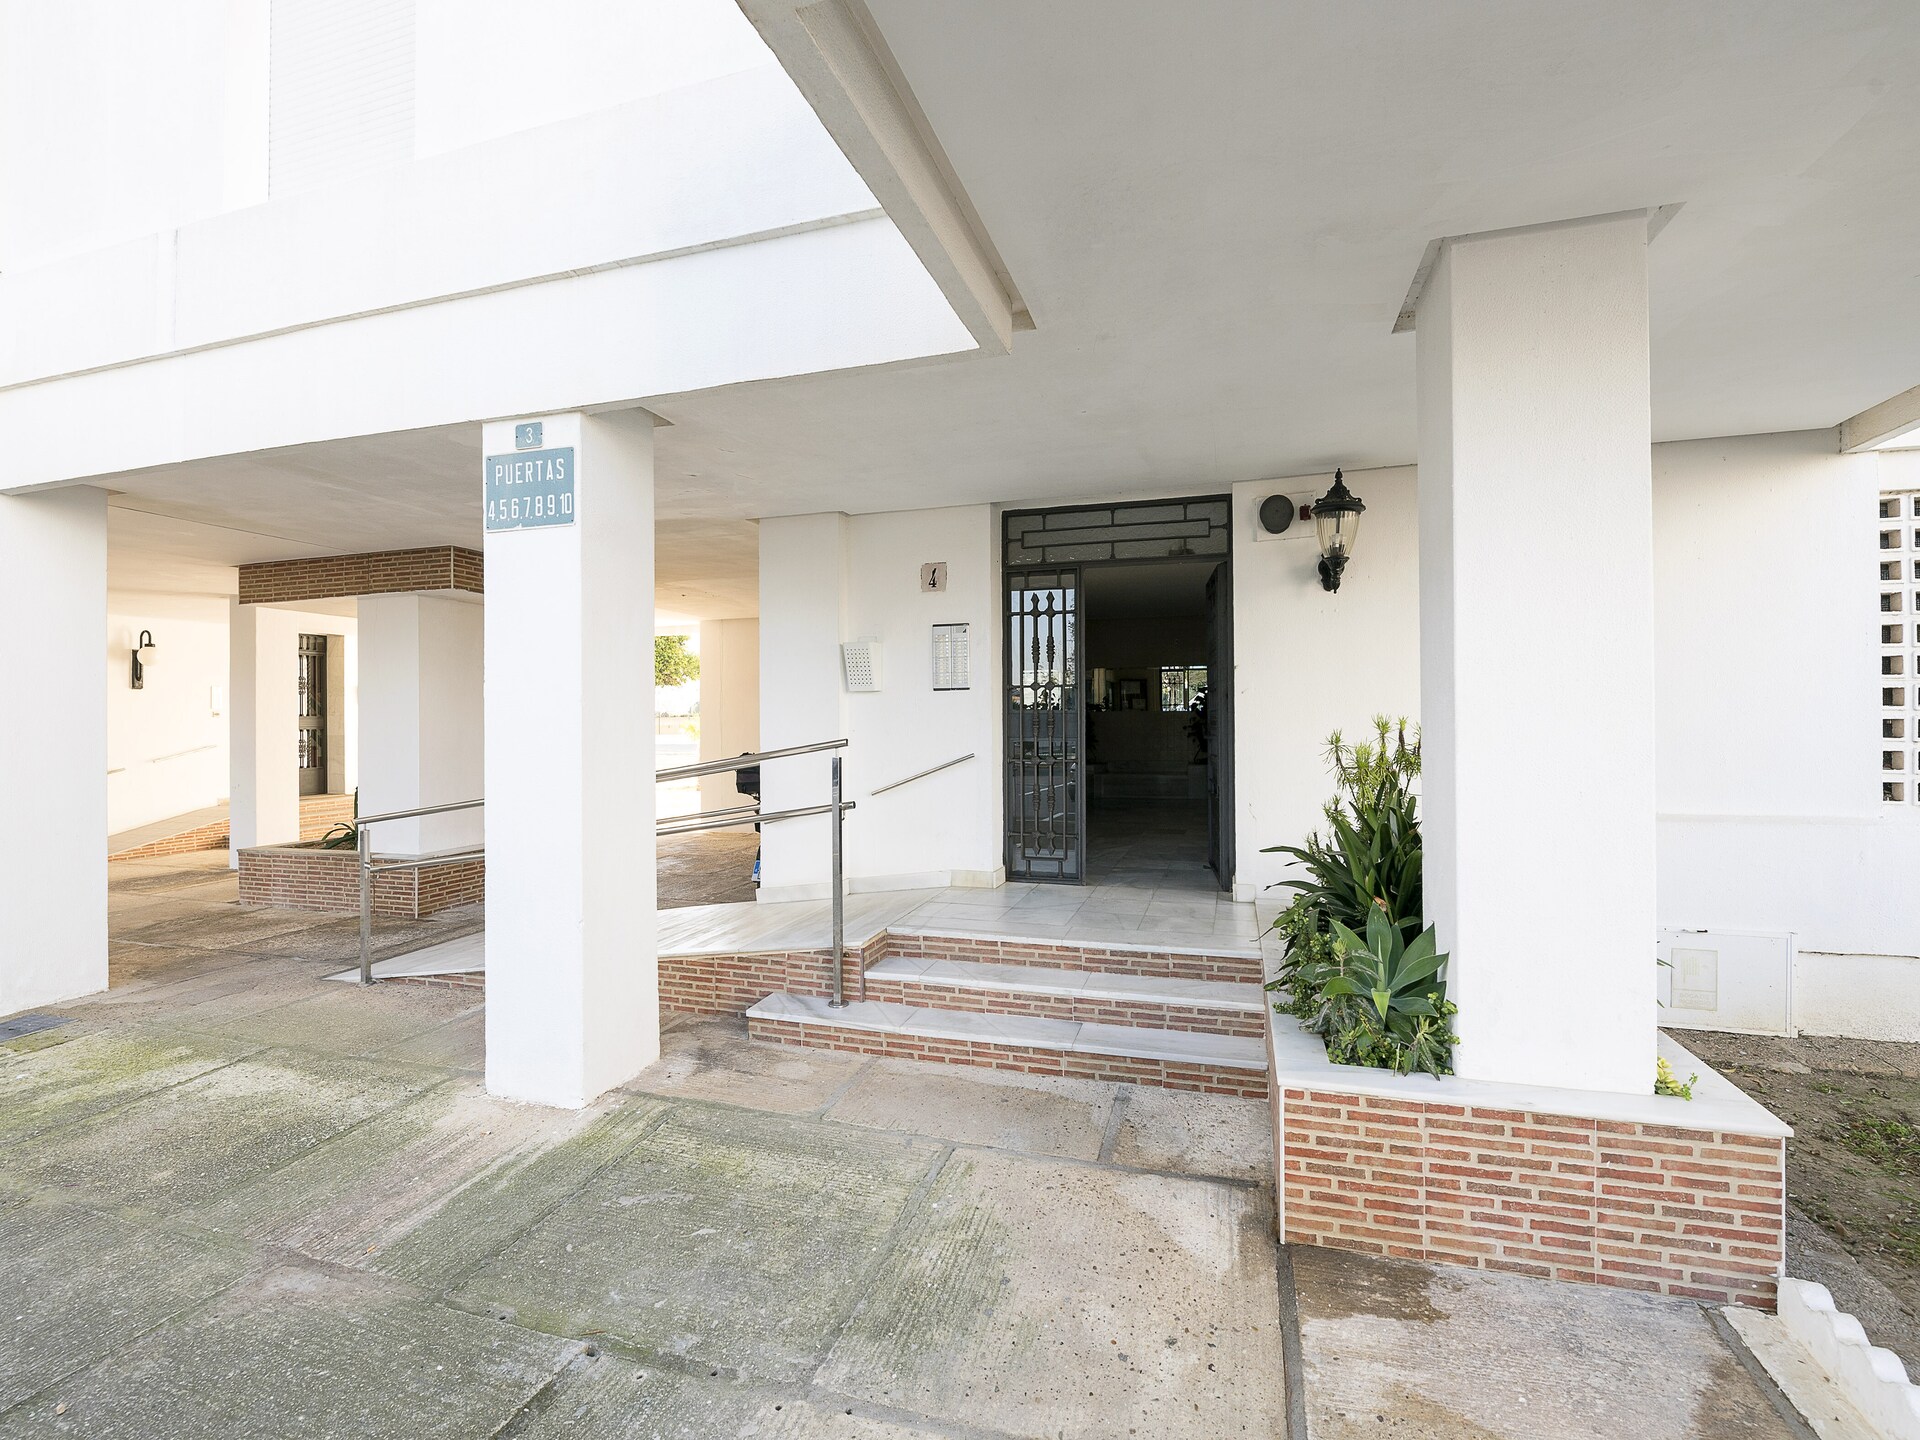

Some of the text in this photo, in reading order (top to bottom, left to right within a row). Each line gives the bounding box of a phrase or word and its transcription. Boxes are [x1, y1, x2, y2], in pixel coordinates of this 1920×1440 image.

[525, 427, 533, 444] 3
[495, 458, 564, 486] PUERTAS
[928, 567, 938, 588] 4
